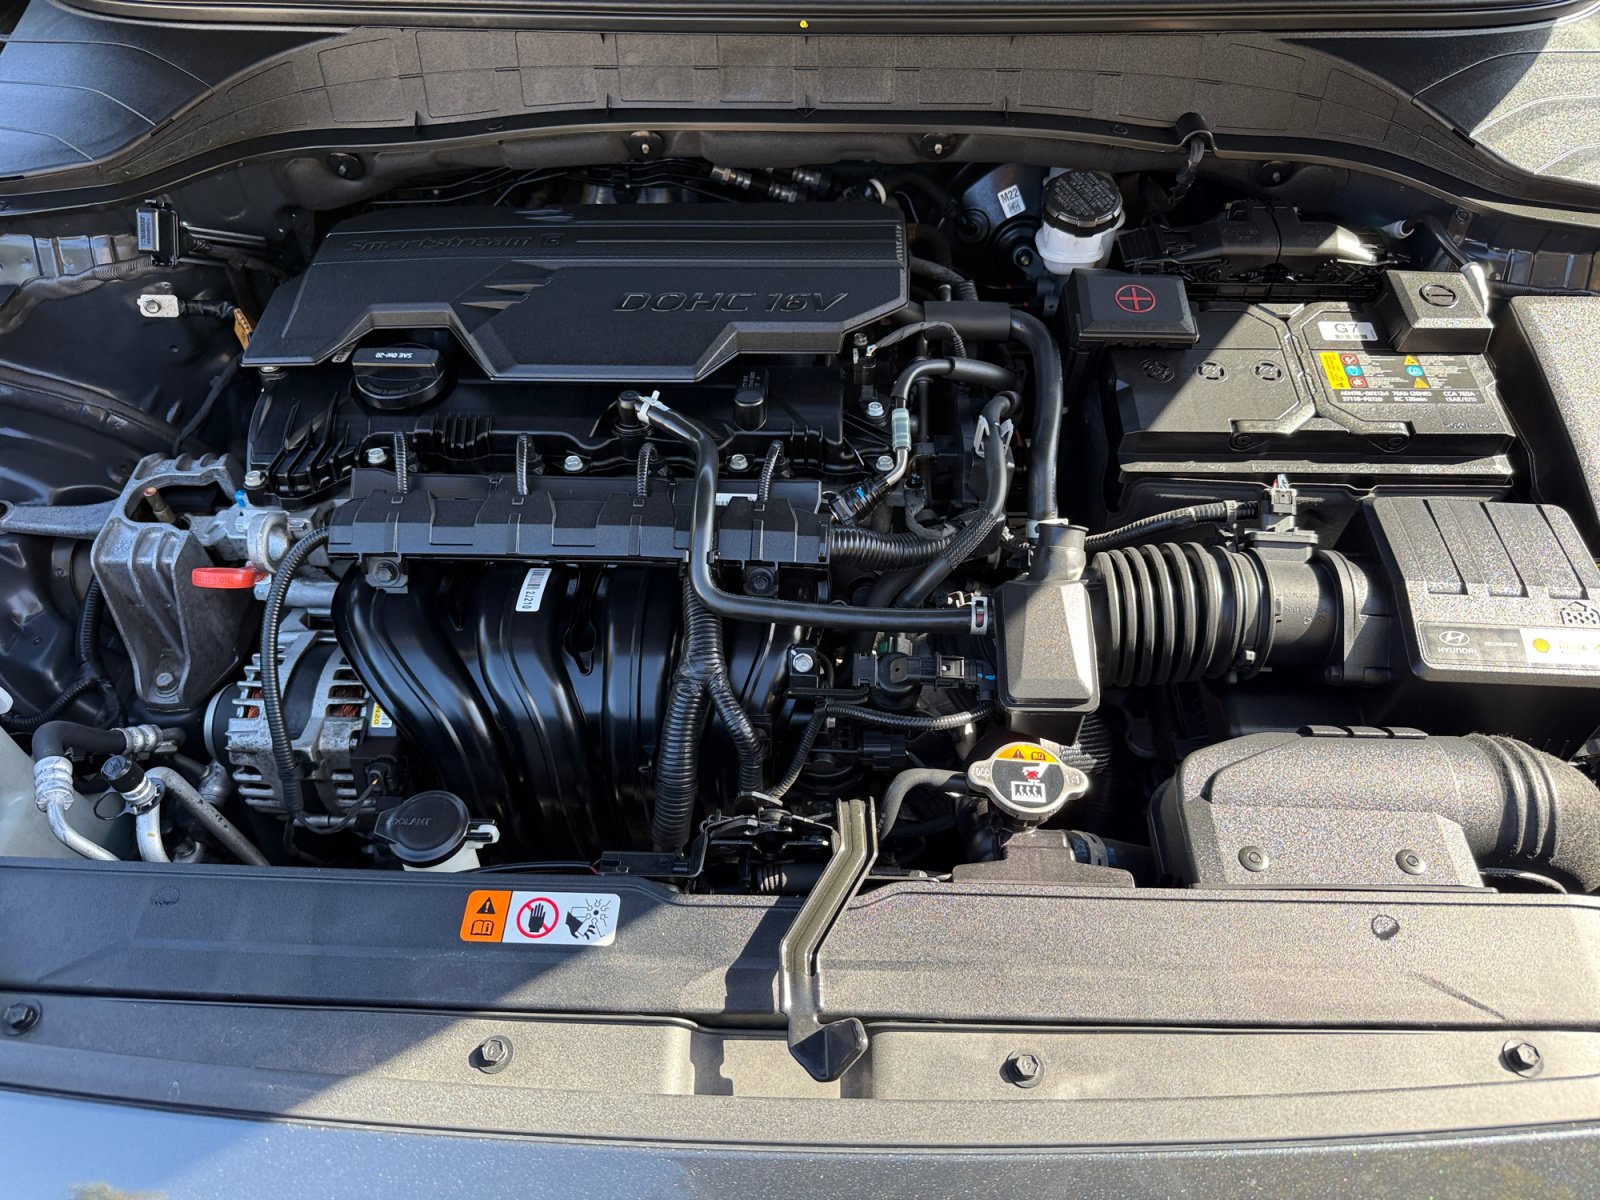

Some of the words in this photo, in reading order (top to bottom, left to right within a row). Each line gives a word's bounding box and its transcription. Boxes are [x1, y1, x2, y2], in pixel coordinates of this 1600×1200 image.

[1000, 188, 1019, 203] M22
[613, 292, 756, 312] DOHC
[765, 292, 848, 312] 16V
[1334, 323, 1358, 333] G7
